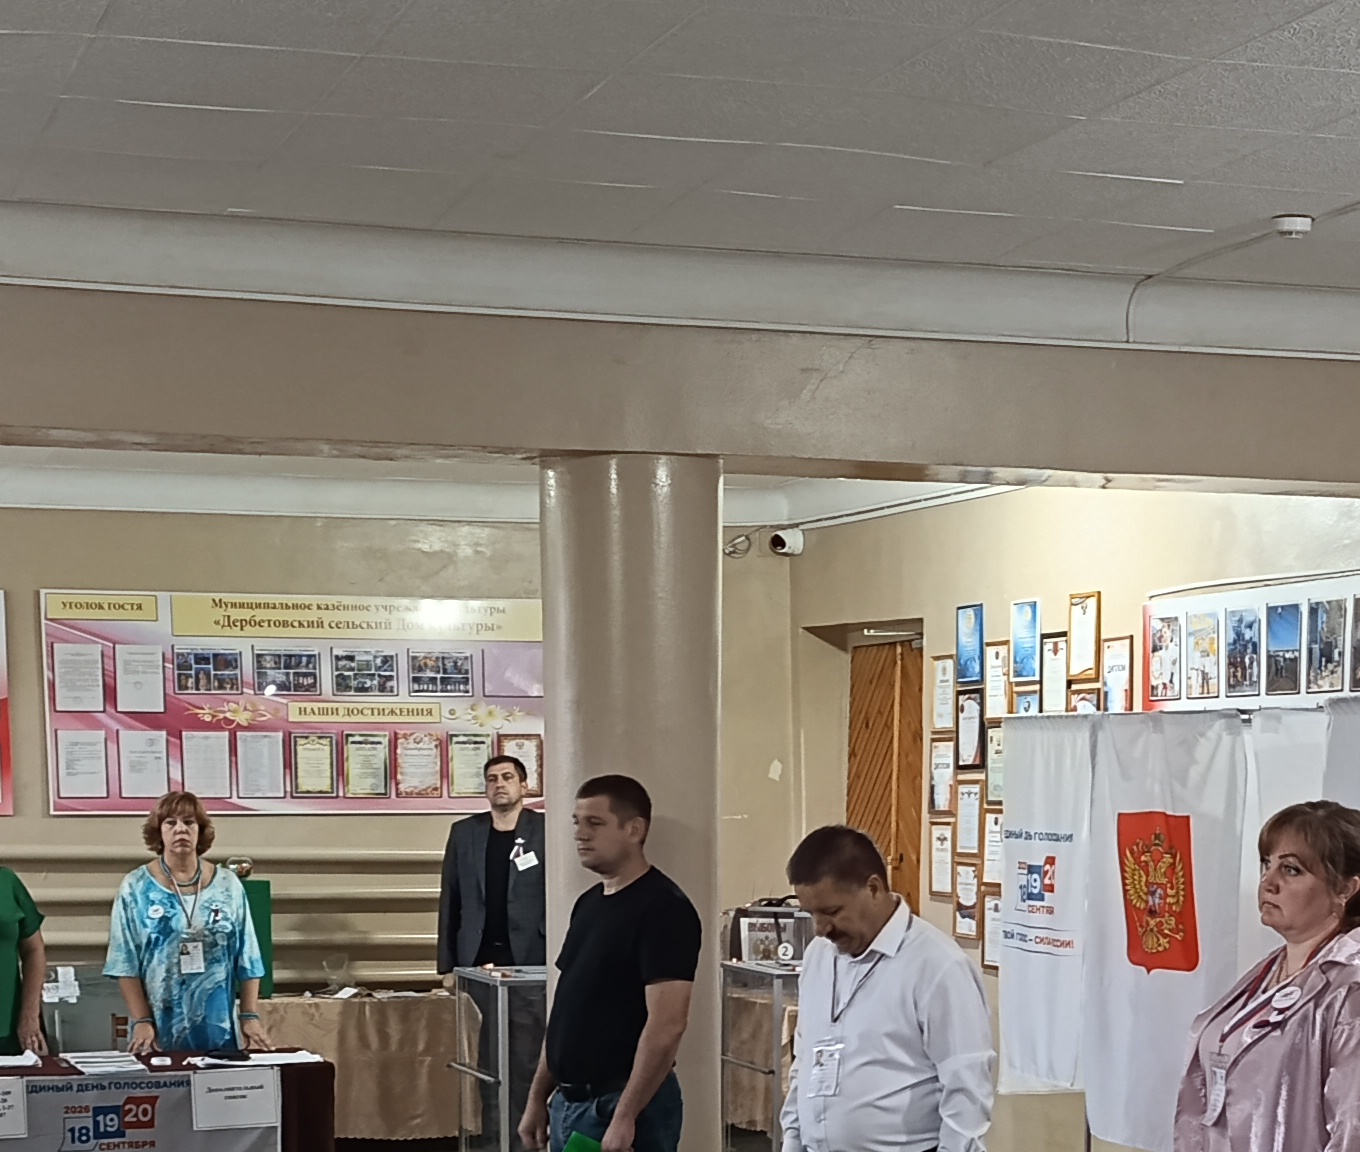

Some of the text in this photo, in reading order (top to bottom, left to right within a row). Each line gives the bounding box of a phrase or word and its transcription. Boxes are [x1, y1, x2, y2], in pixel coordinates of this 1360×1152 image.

[61, 600, 144, 612] УГОЛОК ГОСТЯ
[211, 598, 313, 612] Муниципальное
[316, 600, 372, 612] казённое
[213, 614, 324, 632] «Дербетовский
[328, 616, 392, 631] сельский
[298, 706, 435, 718] НАШИ ДОСТИЖЕНИЯ
[1027, 874, 1040, 894] 19
[782, 946, 789, 956] 2
[76, 1083, 106, 1093] ДЕНЬ
[108, 1078, 191, 1091] ГОЛОСОВАНИЯ
[63, 1105, 90, 1114] 2026
[123, 1104, 153, 1122] 20
[95, 1113, 119, 1132] 19
[67, 1126, 90, 1144] 18
[98, 1140, 156, 1151] СЕНТЯБРЯ
